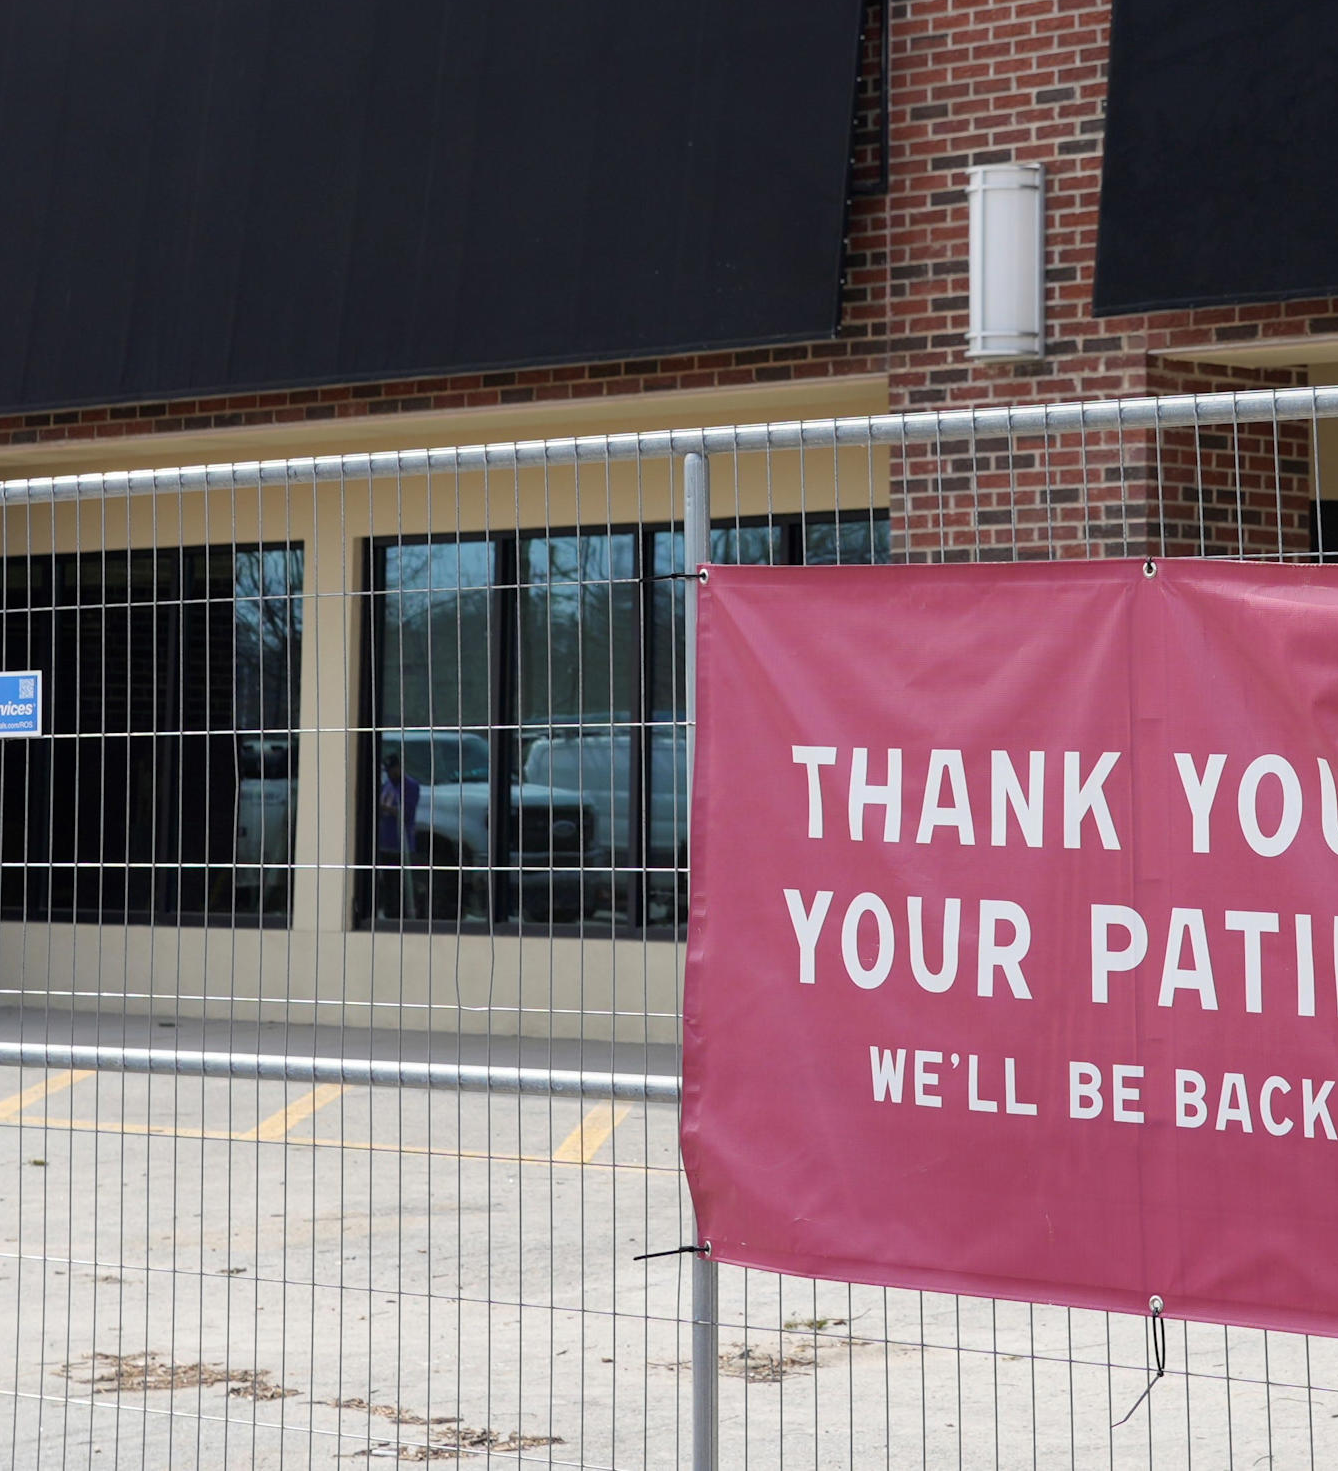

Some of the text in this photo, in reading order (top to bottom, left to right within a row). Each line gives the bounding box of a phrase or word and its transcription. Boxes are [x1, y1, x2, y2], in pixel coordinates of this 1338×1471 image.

[791, 745, 1122, 851] THANK
[783, 888, 1034, 1000] YOUR
[1069, 1061, 1145, 1125] BE
[1175, 1068, 1338, 1141] BACK
